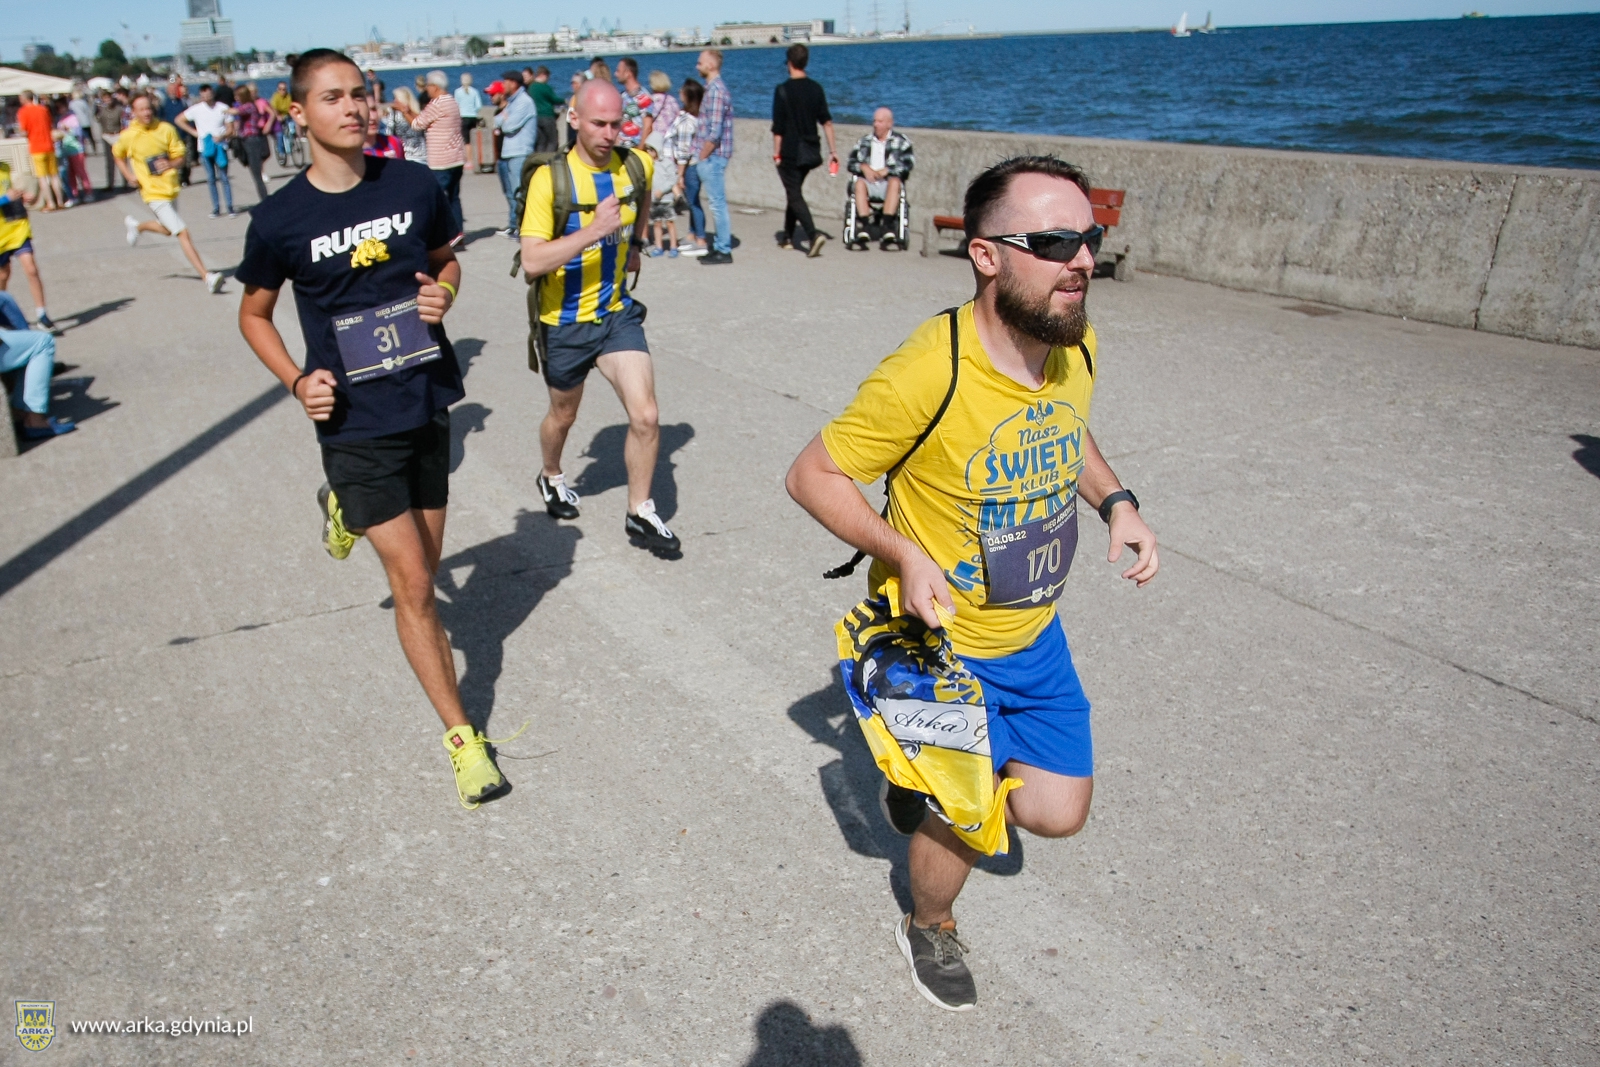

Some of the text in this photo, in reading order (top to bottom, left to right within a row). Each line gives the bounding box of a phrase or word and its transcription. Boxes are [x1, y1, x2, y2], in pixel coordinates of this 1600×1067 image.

[311, 211, 413, 263] RUGBY
[373, 323, 402, 354] 31
[1018, 425, 1061, 447] Nasz
[985, 426, 1081, 485] ŚWIĘTY
[1020, 470, 1060, 494] KLUB
[1027, 538, 1061, 583] 170
[887, 708, 969, 734] Arka
